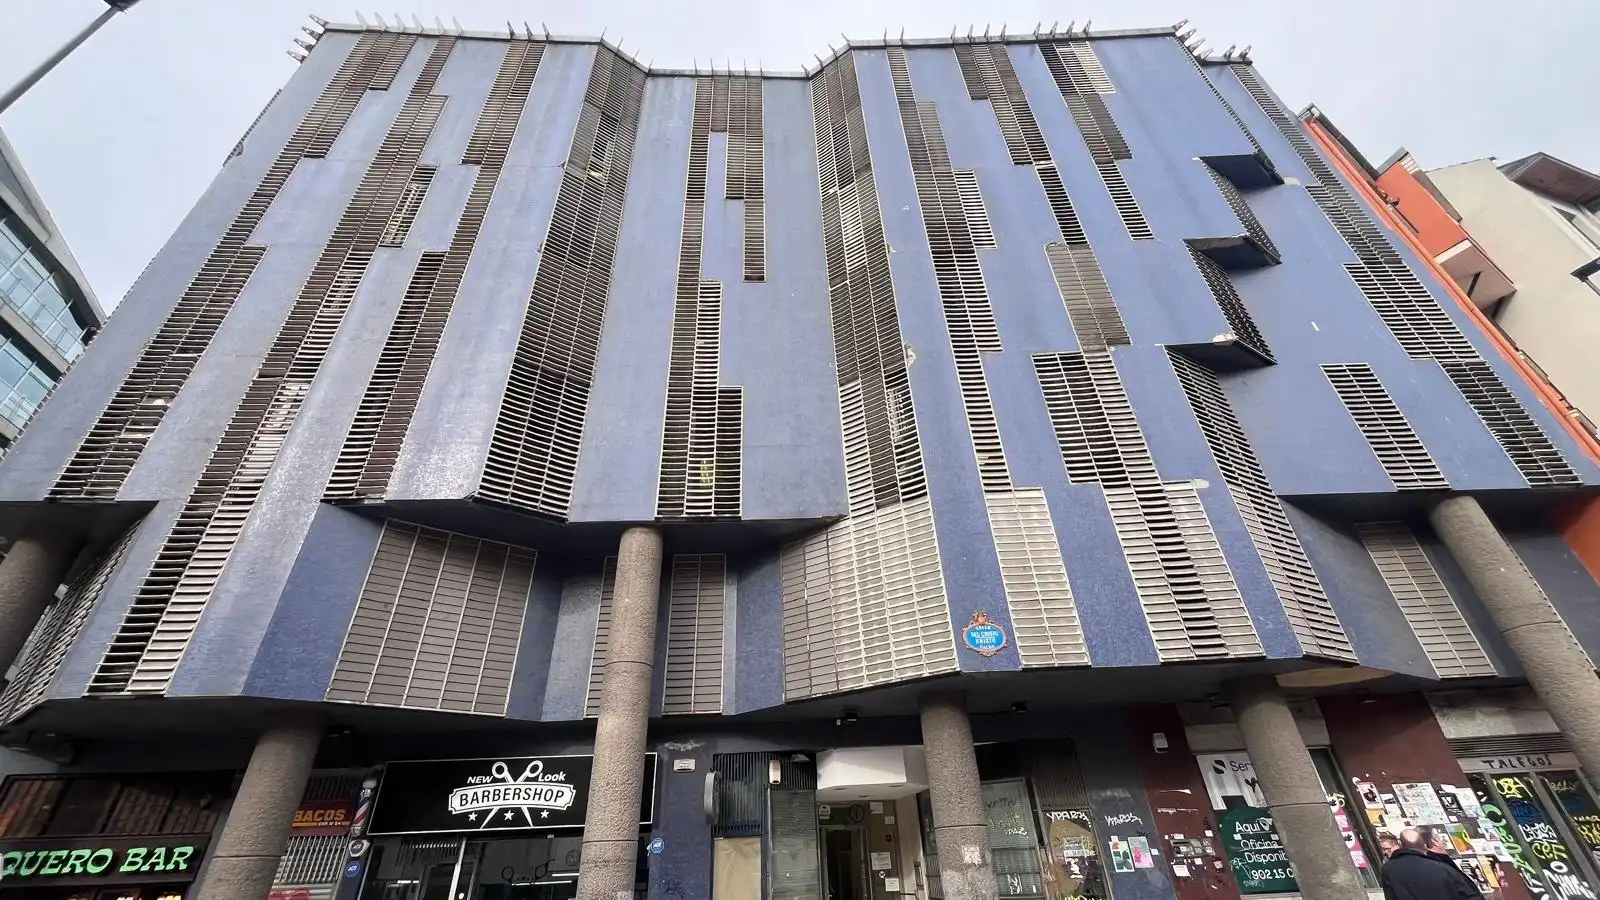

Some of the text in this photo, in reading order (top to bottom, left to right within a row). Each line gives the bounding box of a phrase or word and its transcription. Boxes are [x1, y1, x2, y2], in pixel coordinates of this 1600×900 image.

[467, 771, 566, 784] NEW Look
[460, 787, 565, 807] BARBERSHOP
[1240, 839, 1279, 850] Oficina
[0, 846, 194, 877] QUERO BAR
[1251, 869, 1273, 880] 902
[1274, 868, 1286, 879] 15
